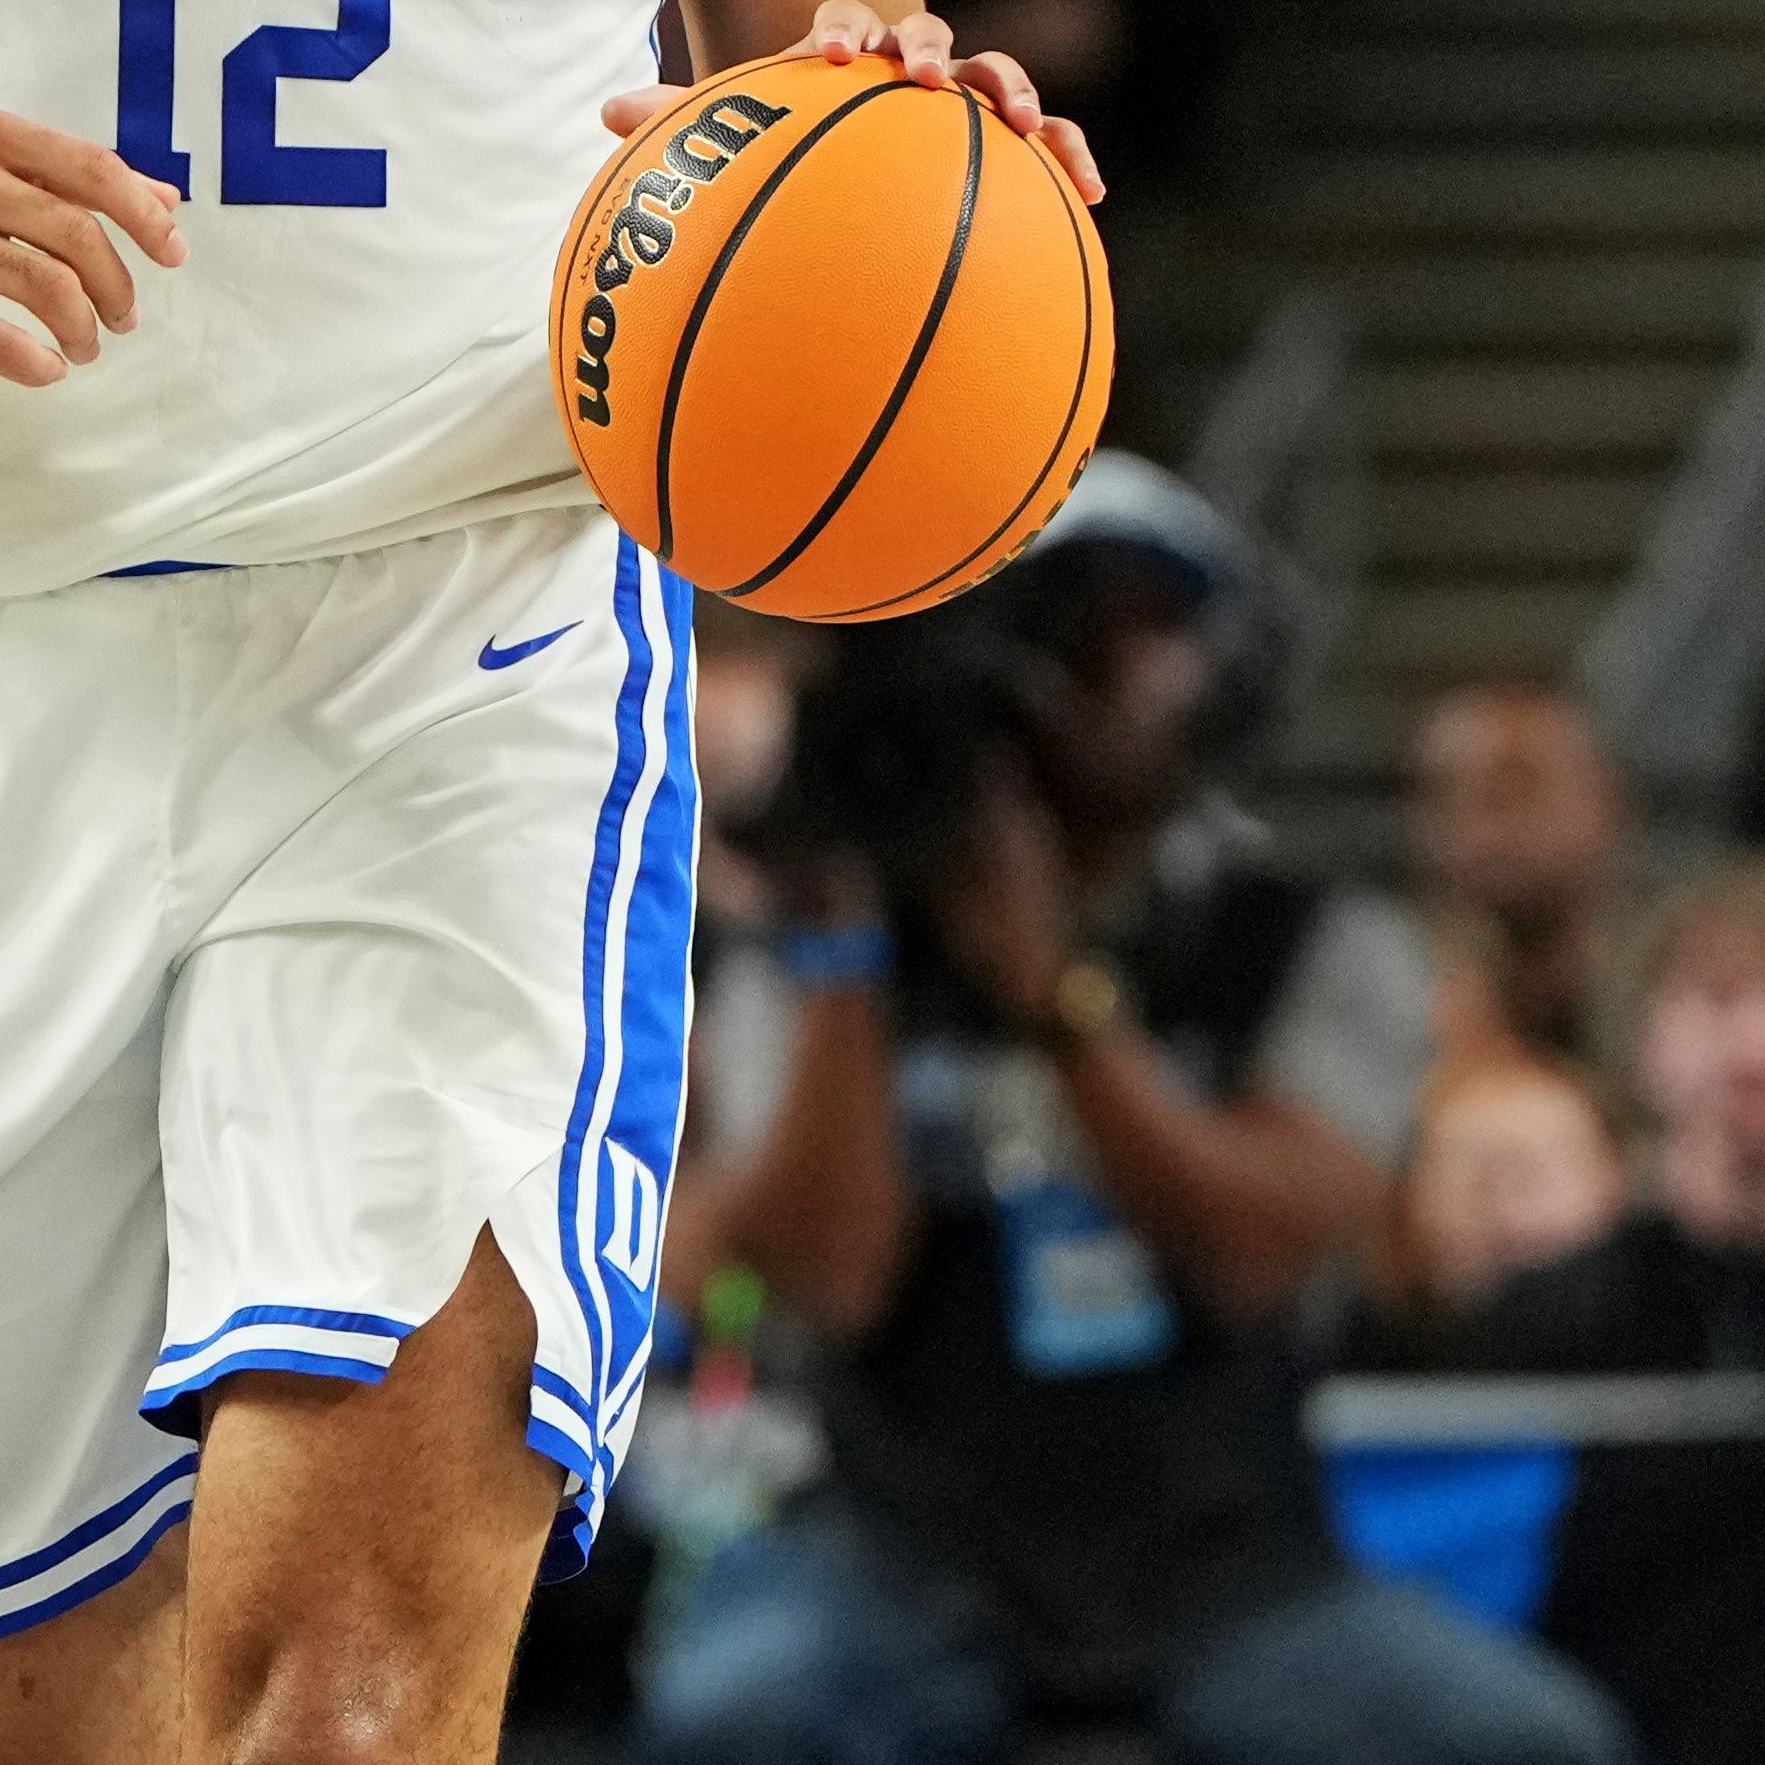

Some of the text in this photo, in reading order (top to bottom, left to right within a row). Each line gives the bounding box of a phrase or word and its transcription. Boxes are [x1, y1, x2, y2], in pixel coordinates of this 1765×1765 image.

[576, 92, 793, 429] Wilson
[579, 234, 602, 287] NXT
[601, 1136, 659, 1293] D
